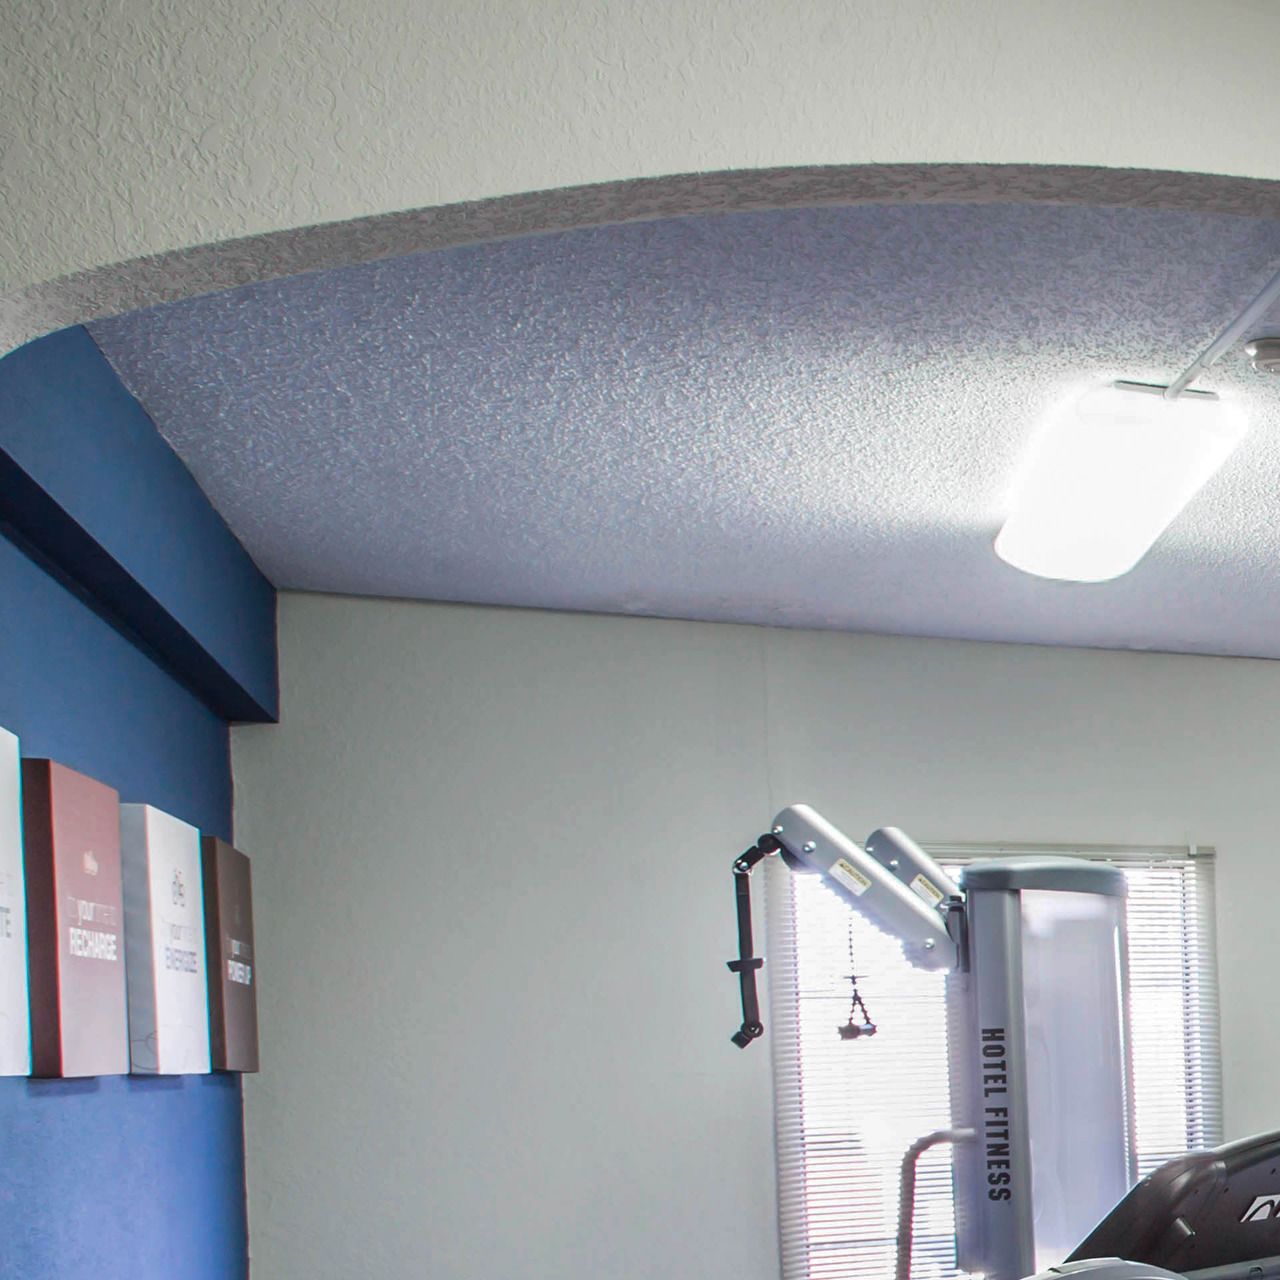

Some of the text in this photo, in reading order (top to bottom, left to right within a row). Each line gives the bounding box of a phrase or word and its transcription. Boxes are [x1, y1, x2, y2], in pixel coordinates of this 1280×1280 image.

[69, 926, 117, 961] RECHARGE
[981, 1028, 1012, 1202] HOTEL FITNESS
